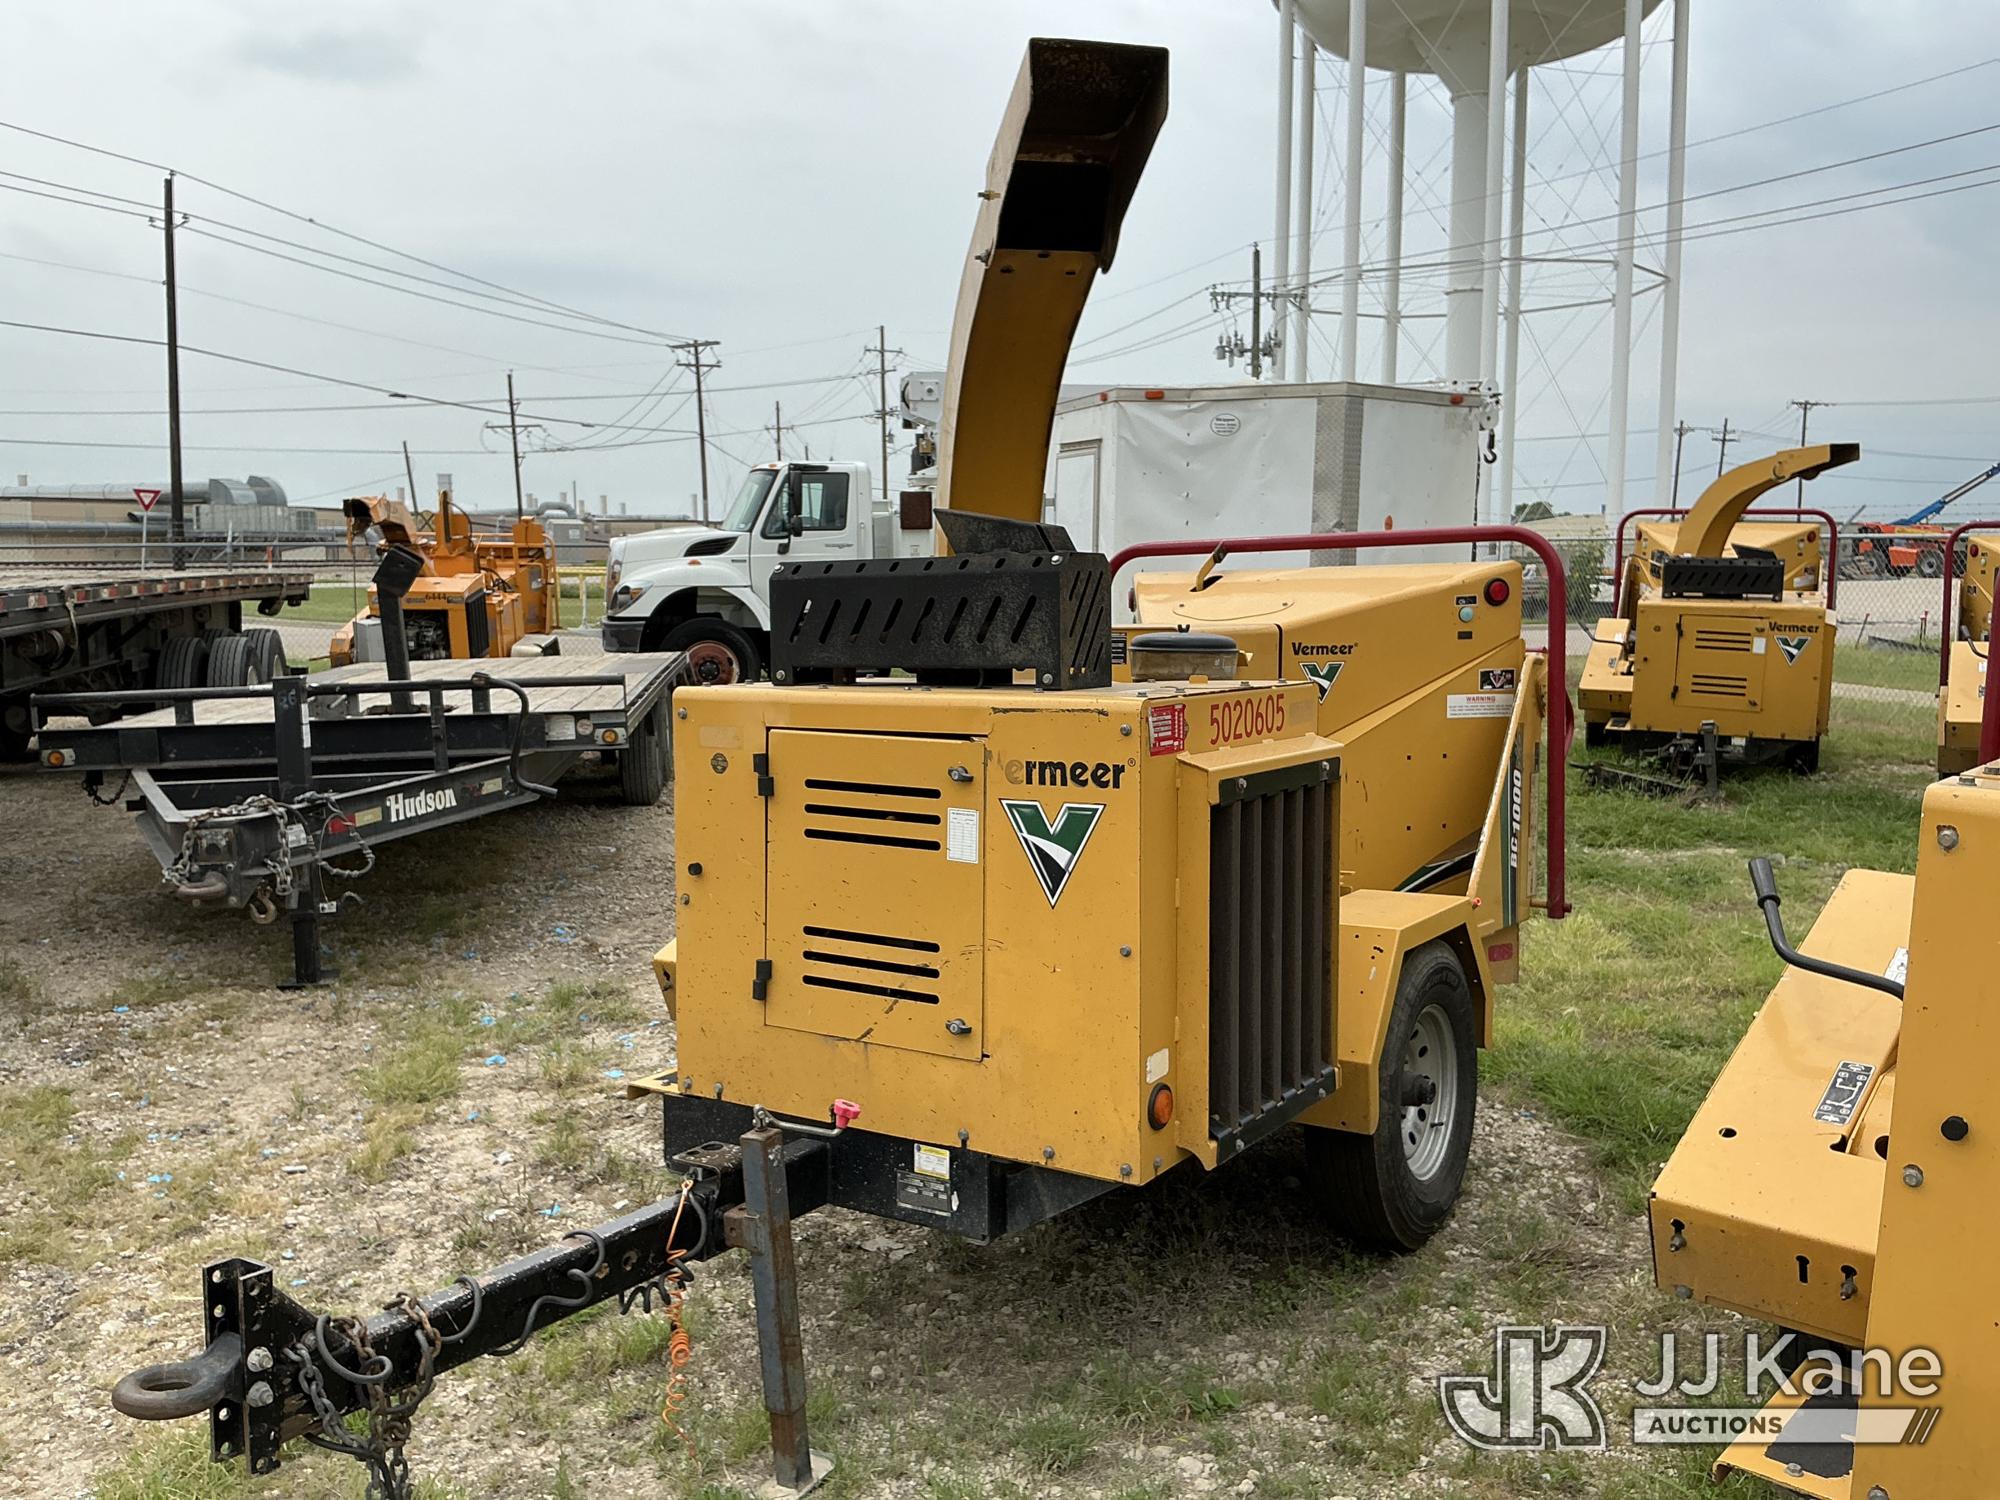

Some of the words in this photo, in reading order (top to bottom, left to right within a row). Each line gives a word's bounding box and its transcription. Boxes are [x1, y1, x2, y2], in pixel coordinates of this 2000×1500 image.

[1769, 622, 1819, 633] Vermeer
[1291, 641, 1355, 656] Vermeer
[1466, 695, 1496, 703] WARNING
[1210, 693, 1286, 745] 5020605
[998, 752, 1127, 790] ermeer
[386, 787, 458, 823] Hudson
[1510, 768, 1522, 868] BC1000
